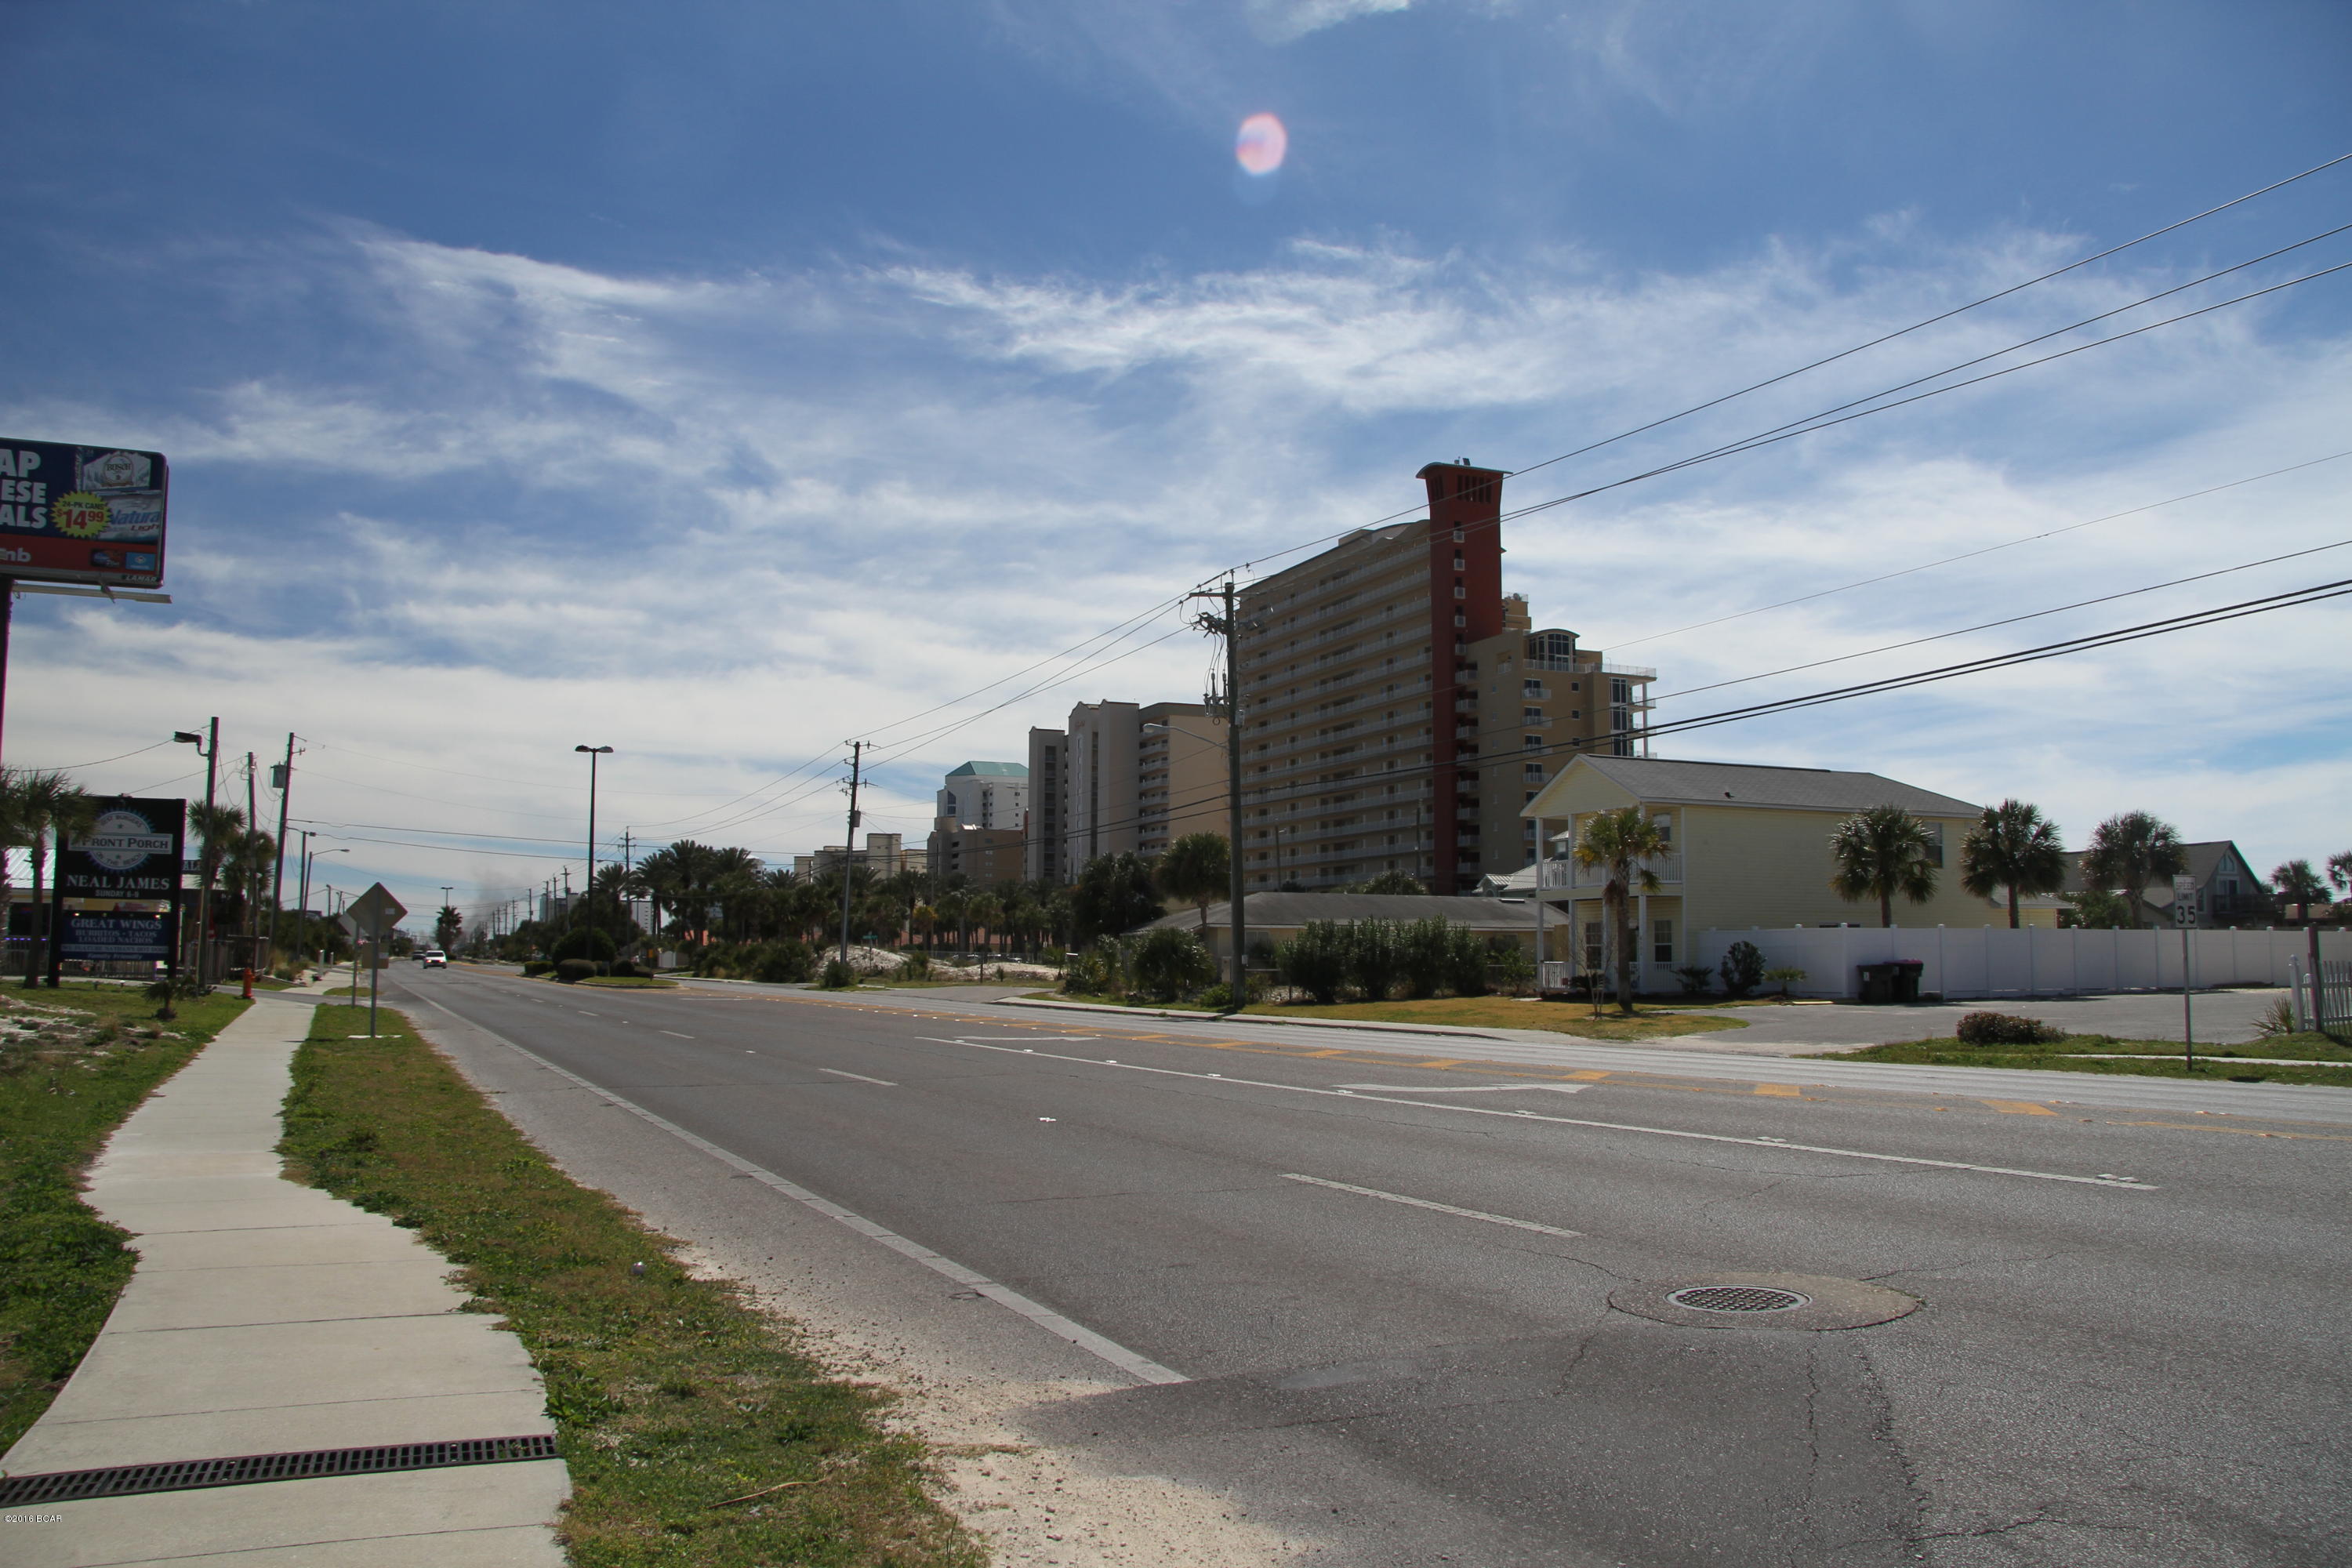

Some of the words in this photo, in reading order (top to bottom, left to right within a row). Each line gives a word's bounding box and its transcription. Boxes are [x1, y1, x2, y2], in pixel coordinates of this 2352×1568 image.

[125, 575, 157, 583] LAMAR
[128, 837, 169, 849] PORCH
[67, 875, 111, 888] NEAL
[117, 877, 169, 890] JAMES
[2177, 892, 2194, 901] LIMIT
[2177, 906, 2195, 924] 35
[71, 918, 115, 928] GREAT
[120, 920, 162, 930] WINGS
